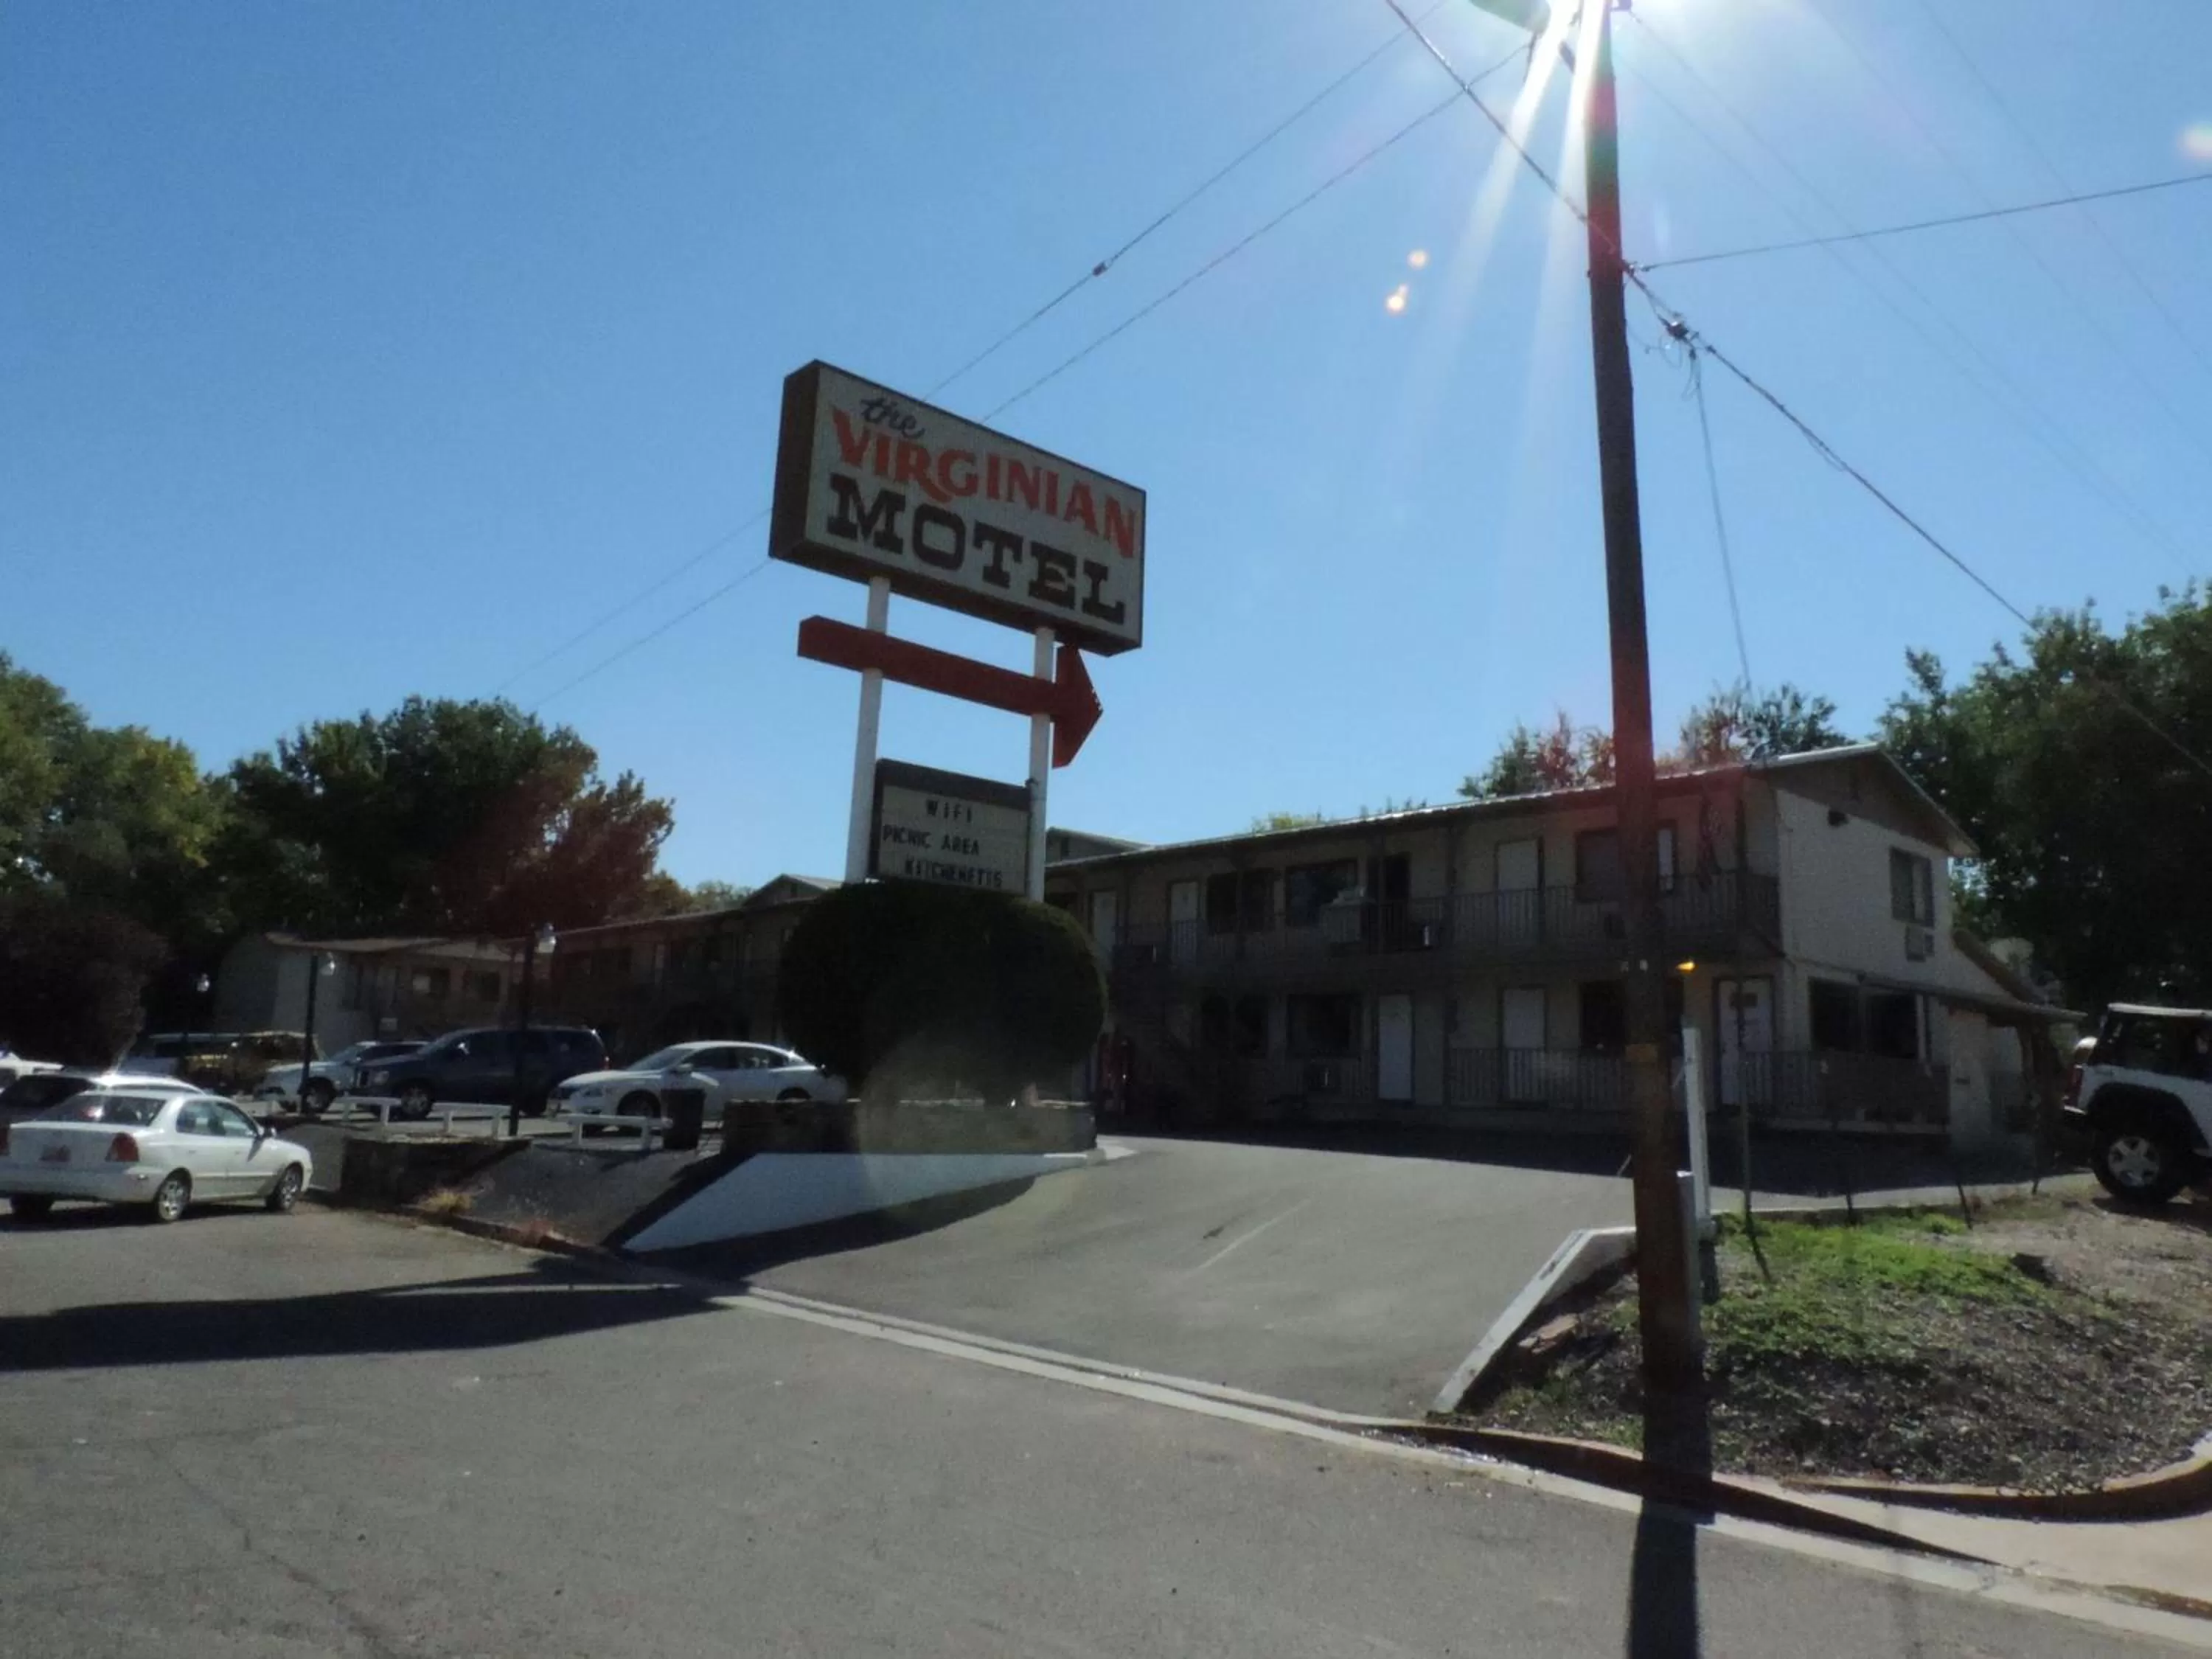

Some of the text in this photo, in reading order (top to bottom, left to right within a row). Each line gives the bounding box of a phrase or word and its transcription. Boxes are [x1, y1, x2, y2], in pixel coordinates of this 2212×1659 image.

[860, 396, 925, 439] the
[831, 406, 1138, 559] VIRGINIAN
[827, 473, 1124, 625] MOTEL
[883, 824, 979, 855] PICNIC AREA
